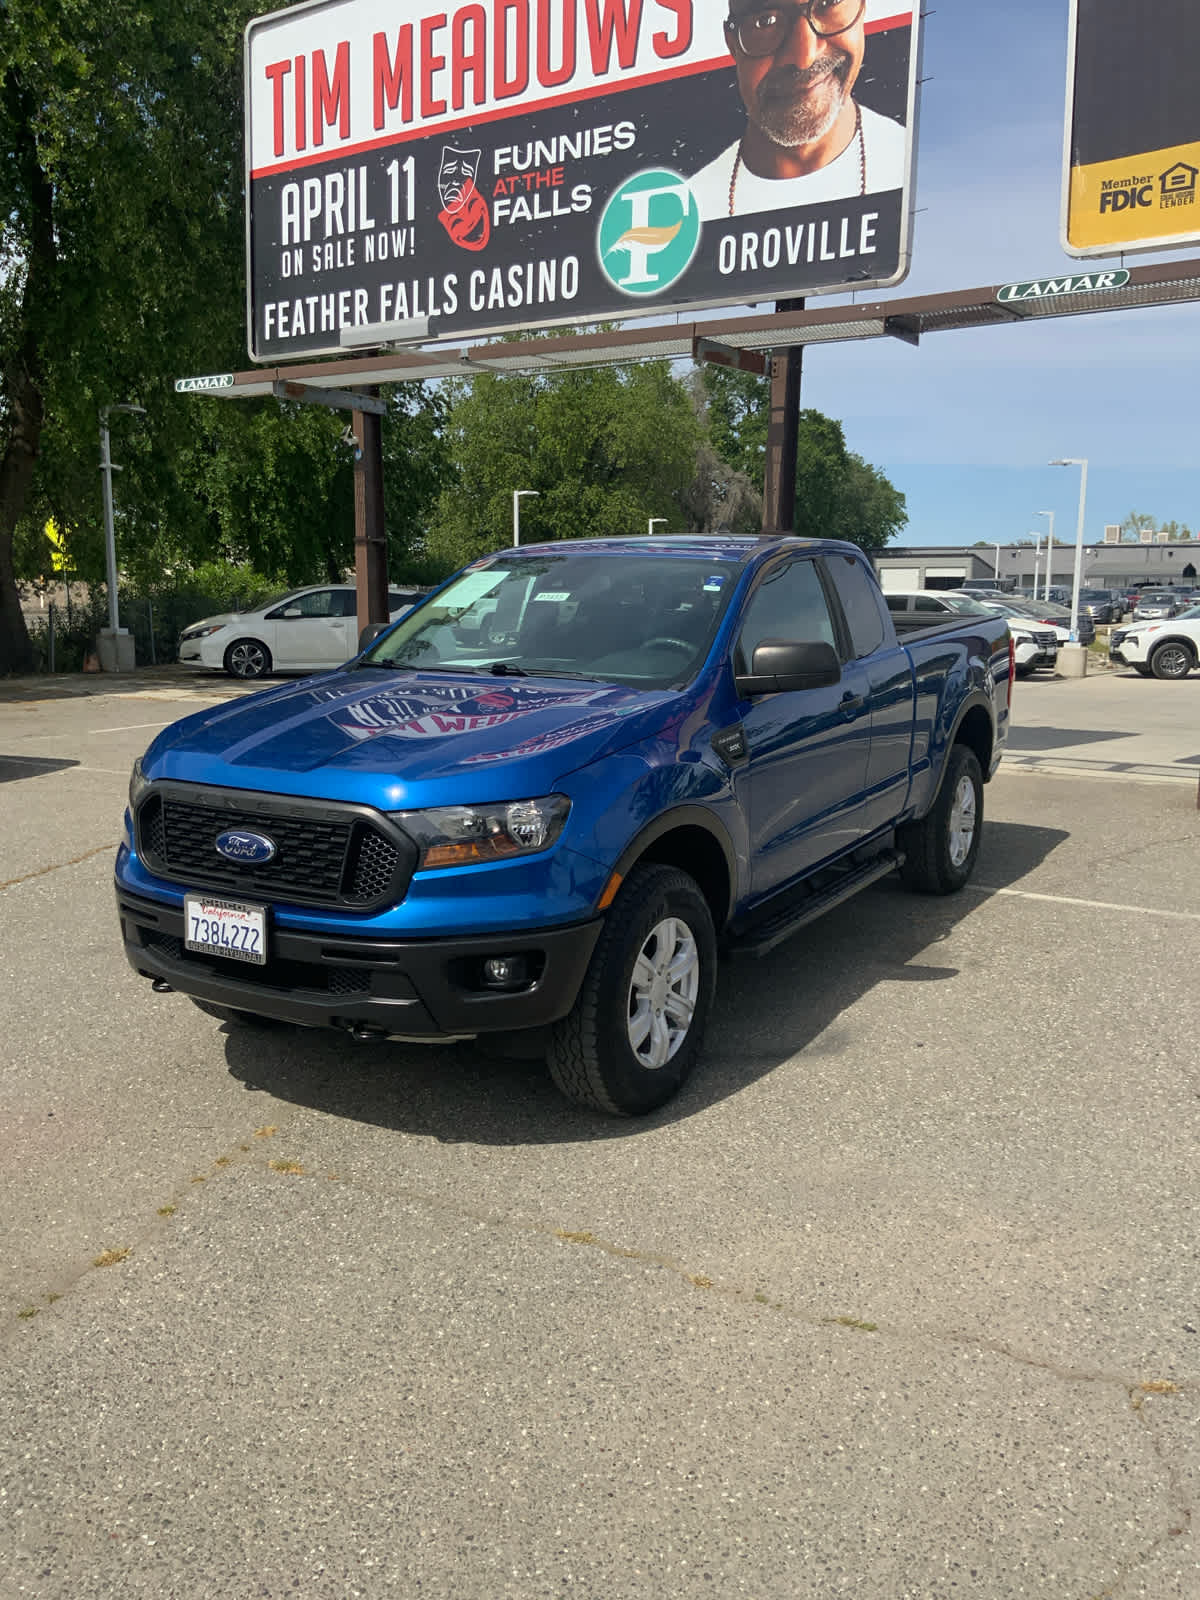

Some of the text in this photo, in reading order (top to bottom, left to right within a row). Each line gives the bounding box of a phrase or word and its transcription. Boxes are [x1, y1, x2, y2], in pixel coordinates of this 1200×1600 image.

[265, 40, 351, 157] TIM
[493, 121, 637, 175] FUNNIES
[281, 155, 416, 246] APRIL 11
[493, 166, 565, 197] AT THE
[1099, 185, 1153, 214] FDIC
[1101, 175, 1154, 191] Member
[493, 184, 593, 227] FALLS
[281, 226, 415, 278] ON SALE NOW!
[718, 212, 880, 275] OROVILLE
[264, 255, 580, 341] FEATHER FALLS CASINO
[1007, 273, 1117, 299] LAMAR
[180, 376, 229, 391] LAMAR
[224, 836, 258, 857] Ford
